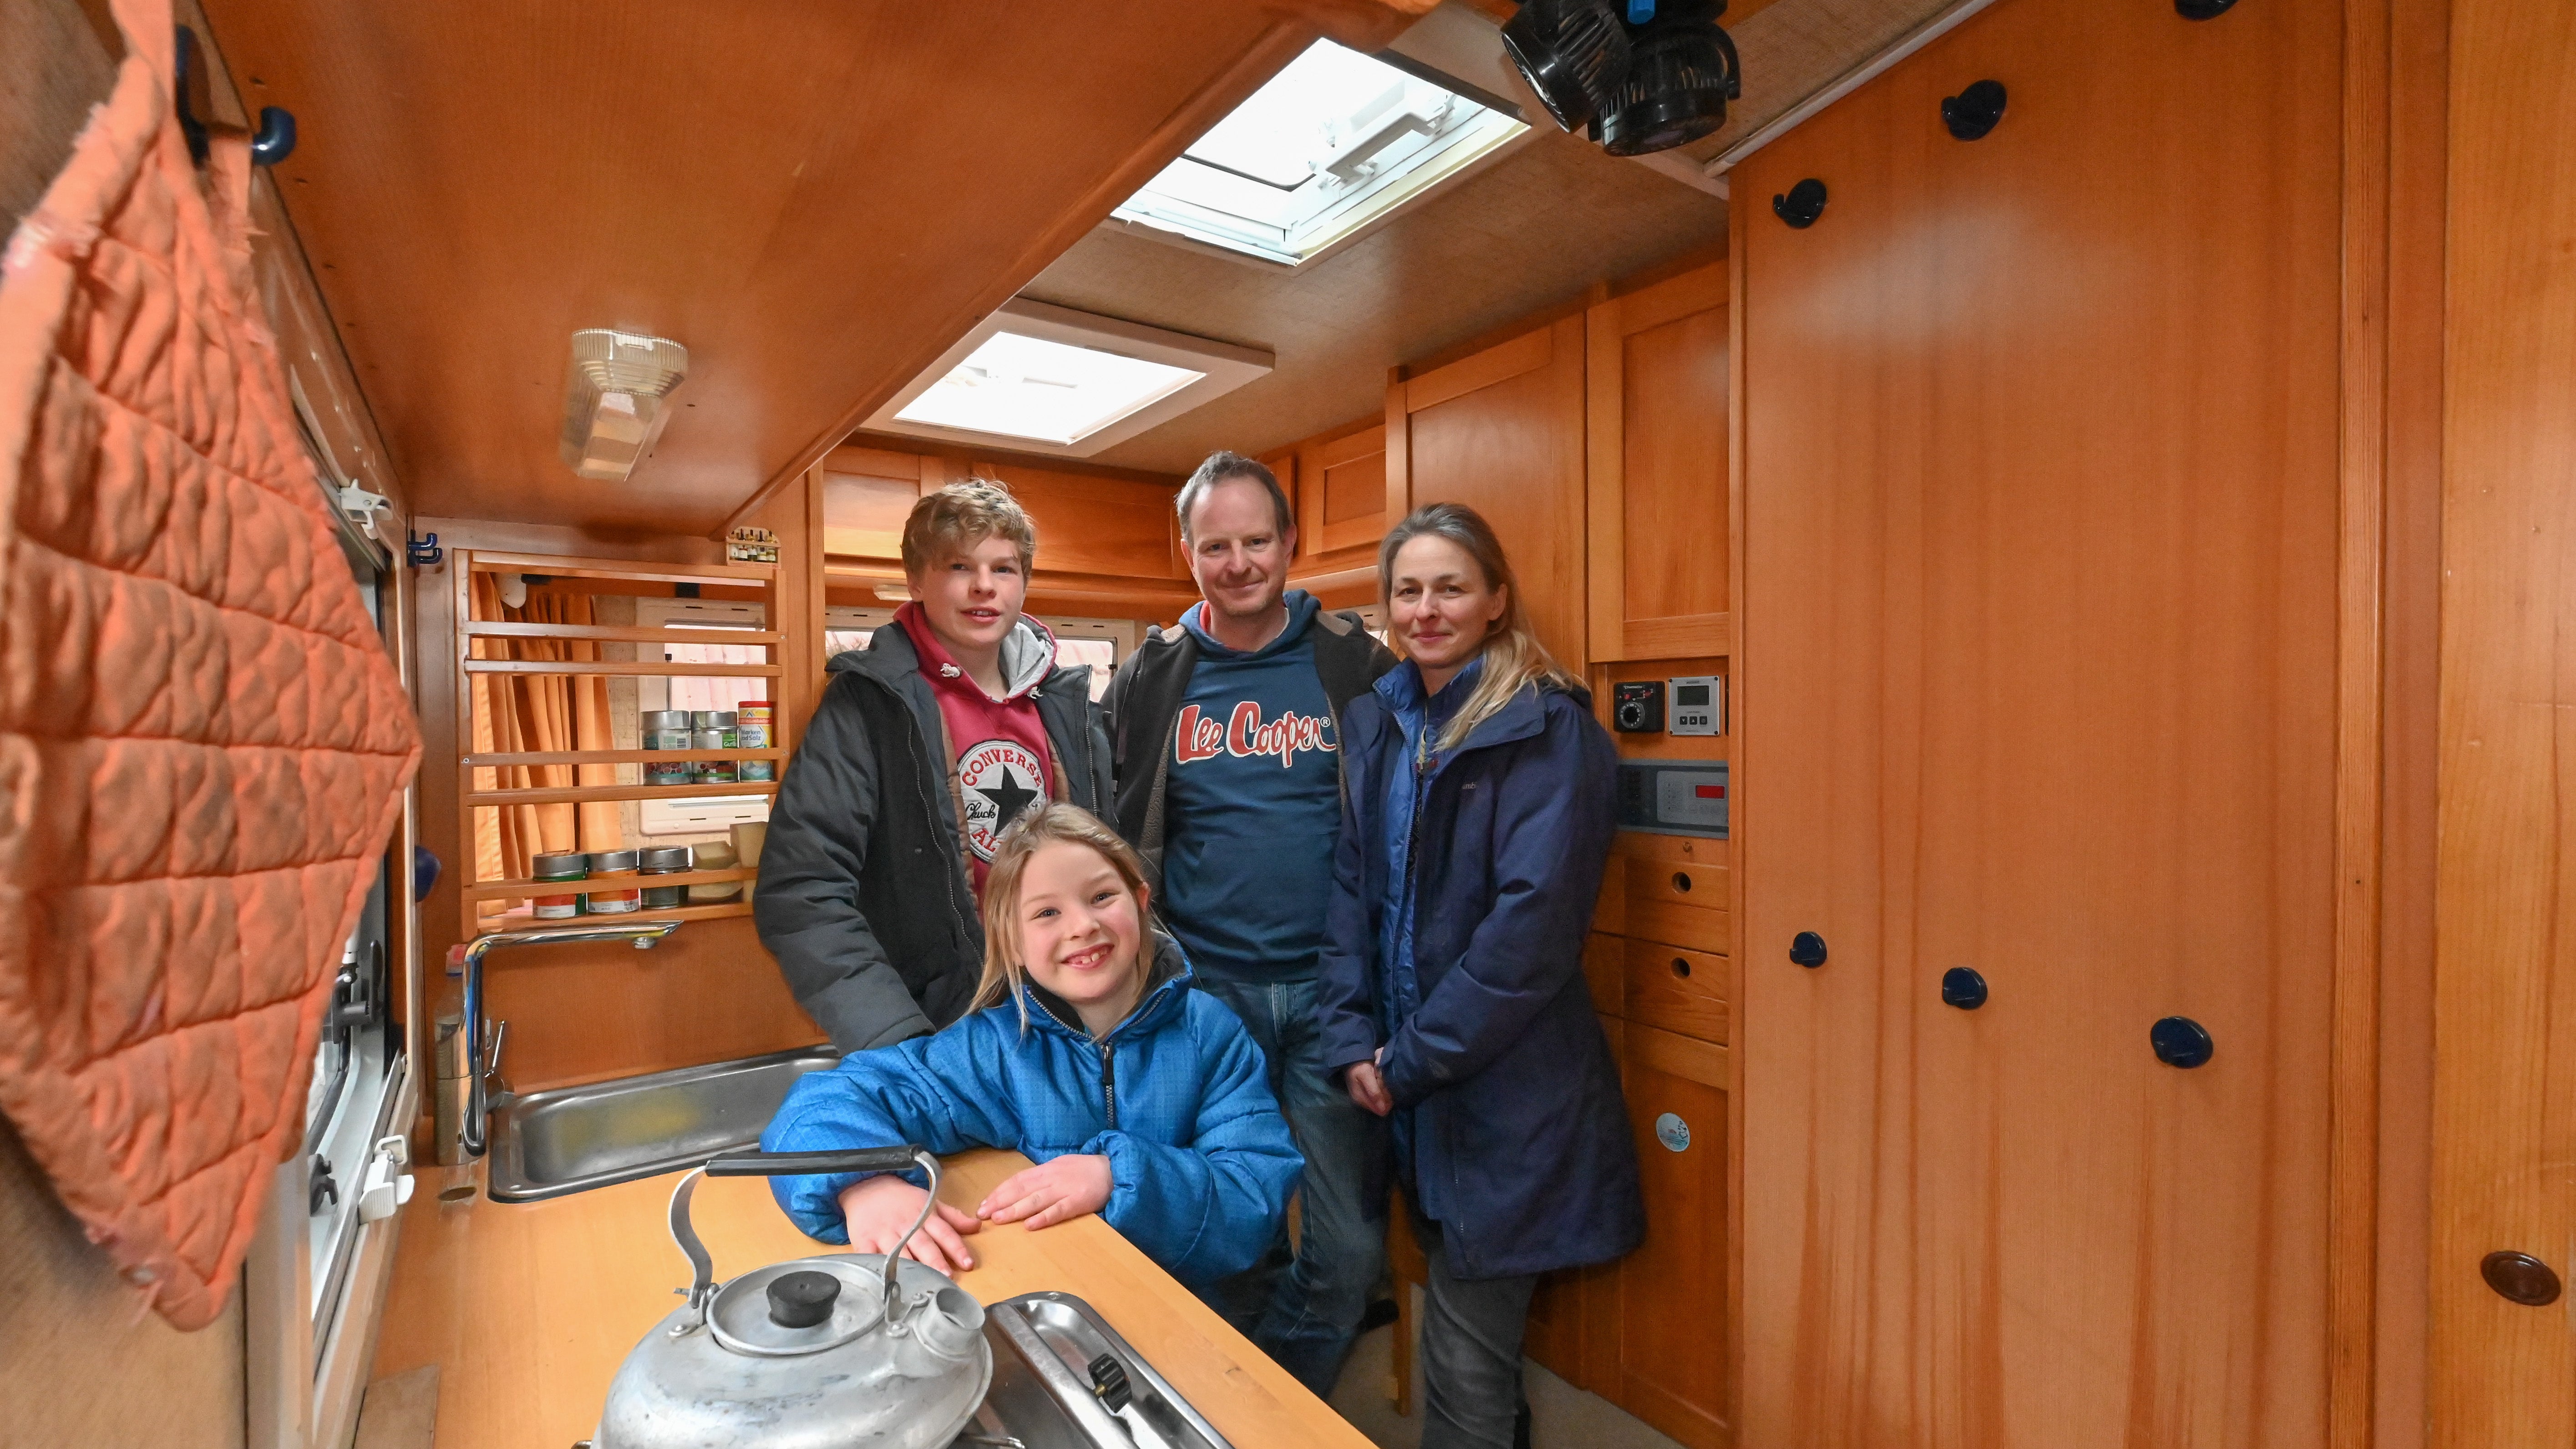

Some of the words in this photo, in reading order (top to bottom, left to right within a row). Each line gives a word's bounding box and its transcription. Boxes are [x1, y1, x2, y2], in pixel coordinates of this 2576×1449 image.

[1176, 704, 1224, 765] Lee
[962, 749, 1042, 787] CONVERSE
[965, 802, 996, 820] Chuck
[971, 827, 1004, 852] AL
